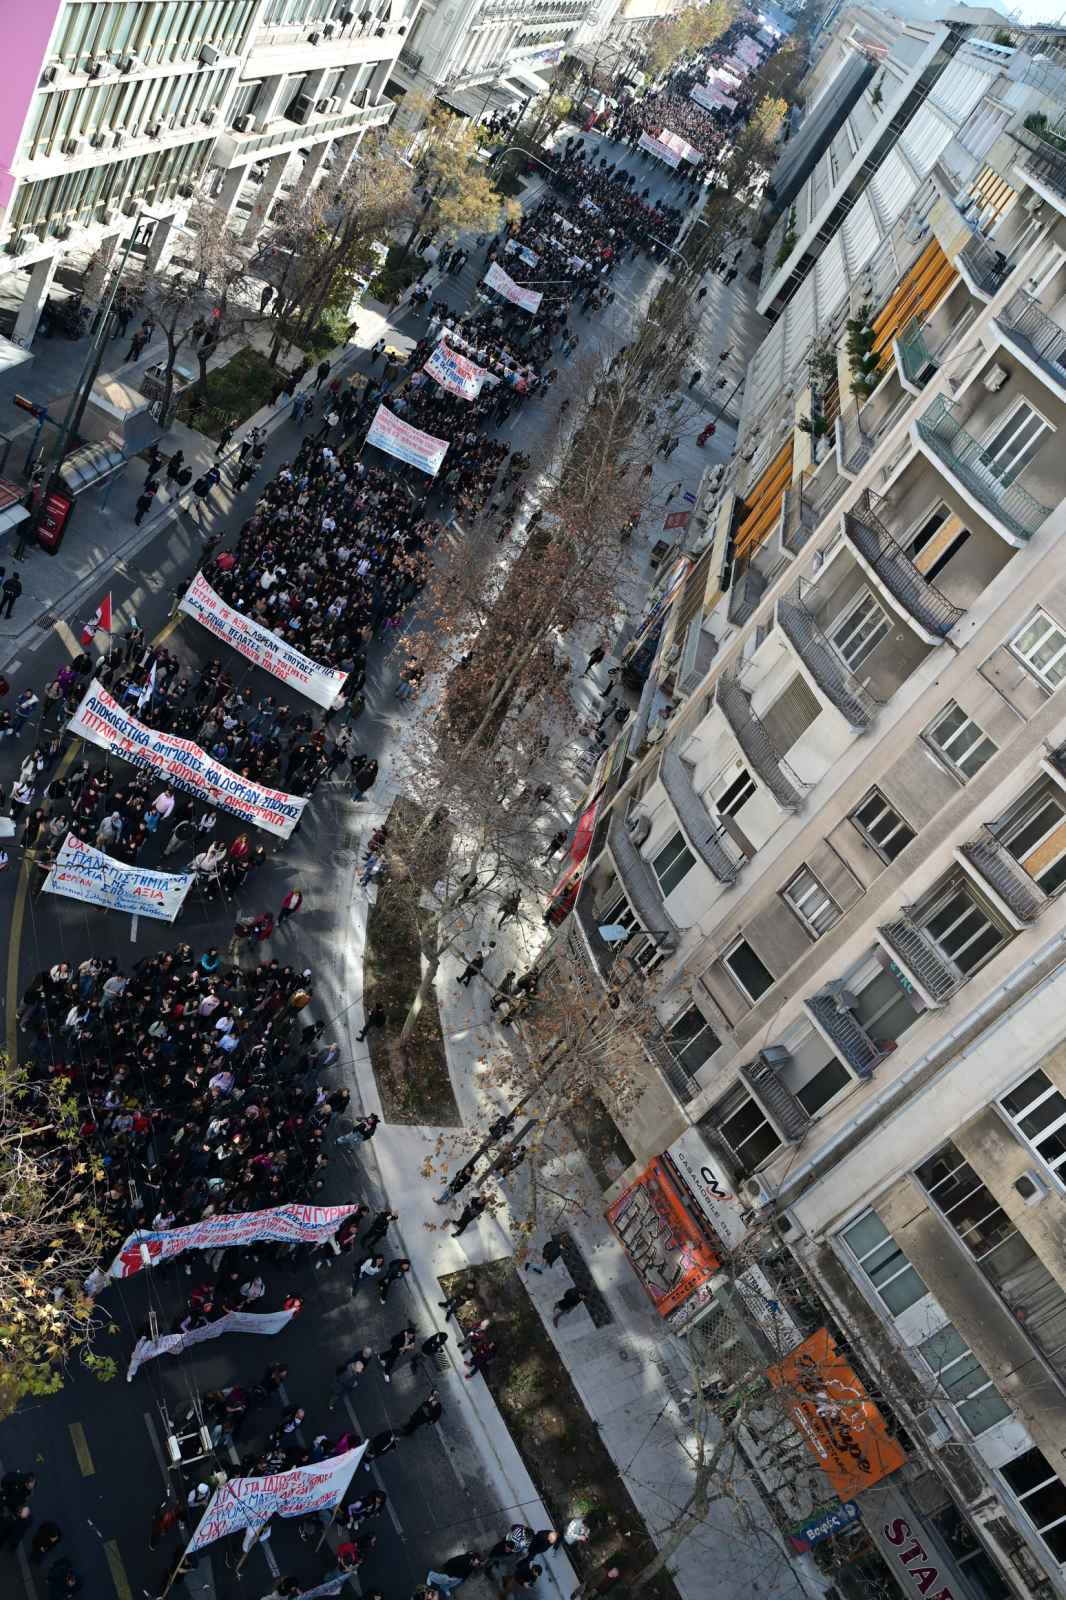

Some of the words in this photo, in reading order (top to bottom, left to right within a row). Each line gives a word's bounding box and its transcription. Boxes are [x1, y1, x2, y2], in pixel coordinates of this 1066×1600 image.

[81, 709, 118, 742] ΠΤΥΧΙΑ
[86, 696, 150, 746] ΑΠΟΚΛΕΙΣΤΙΚΑ
[205, 768, 222, 785] ΚΑΙ
[133, 885, 164, 901] ΑΞΙΑ
